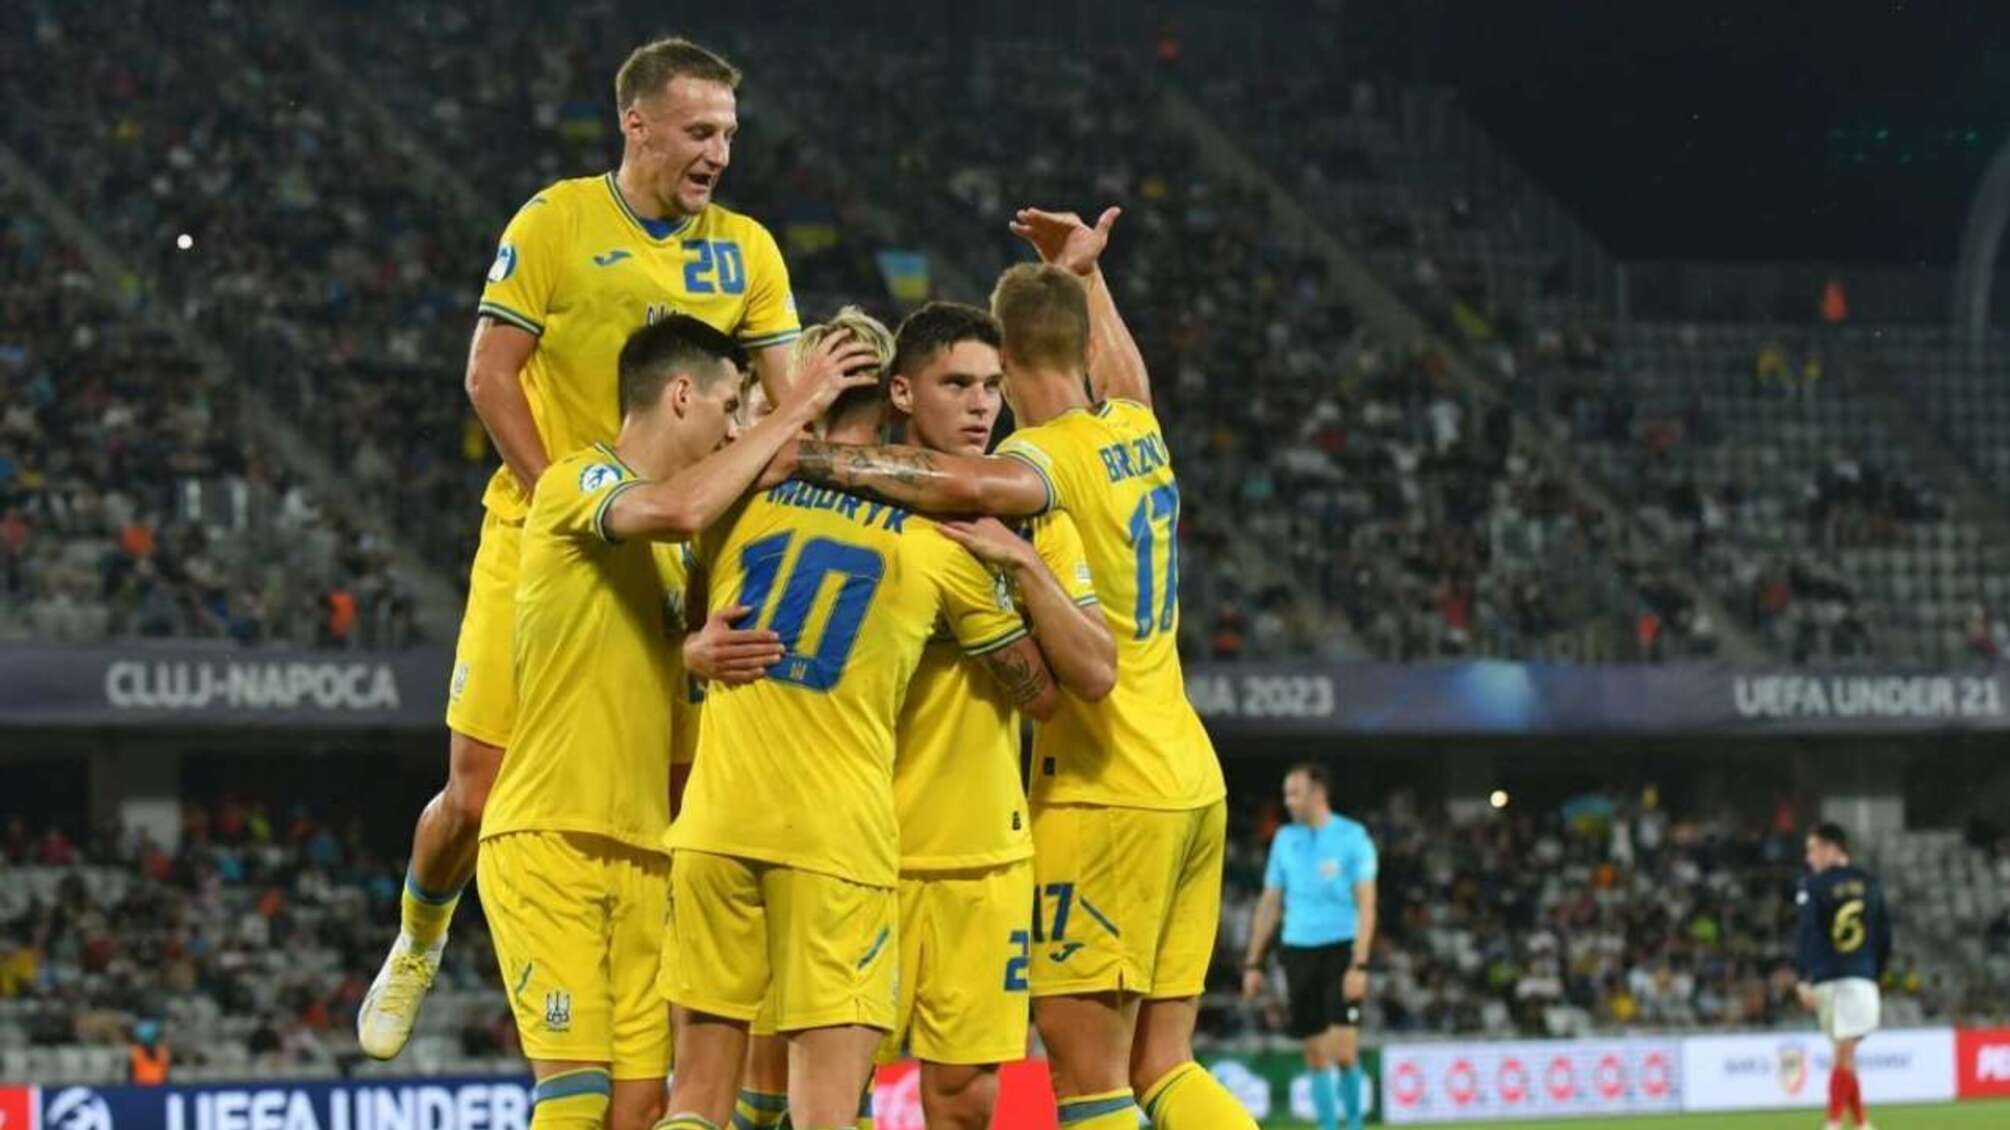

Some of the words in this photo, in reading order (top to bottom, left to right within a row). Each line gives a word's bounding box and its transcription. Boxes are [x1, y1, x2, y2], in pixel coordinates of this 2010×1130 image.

[681, 238, 746, 295] 20
[1129, 480, 1180, 640] 17
[738, 528, 886, 693] 10
[105, 661, 400, 709] CLUJ-NAPOCA
[1243, 675, 1335, 718] 2023
[1734, 675, 1829, 717] UEFA
[1832, 674, 1954, 717] UNDER
[1959, 674, 2000, 717] 21
[1033, 881, 1075, 943] 17
[1831, 899, 1864, 953] 6
[165, 1090, 321, 1130] UEFA
[329, 1084, 529, 1130] UNDER
